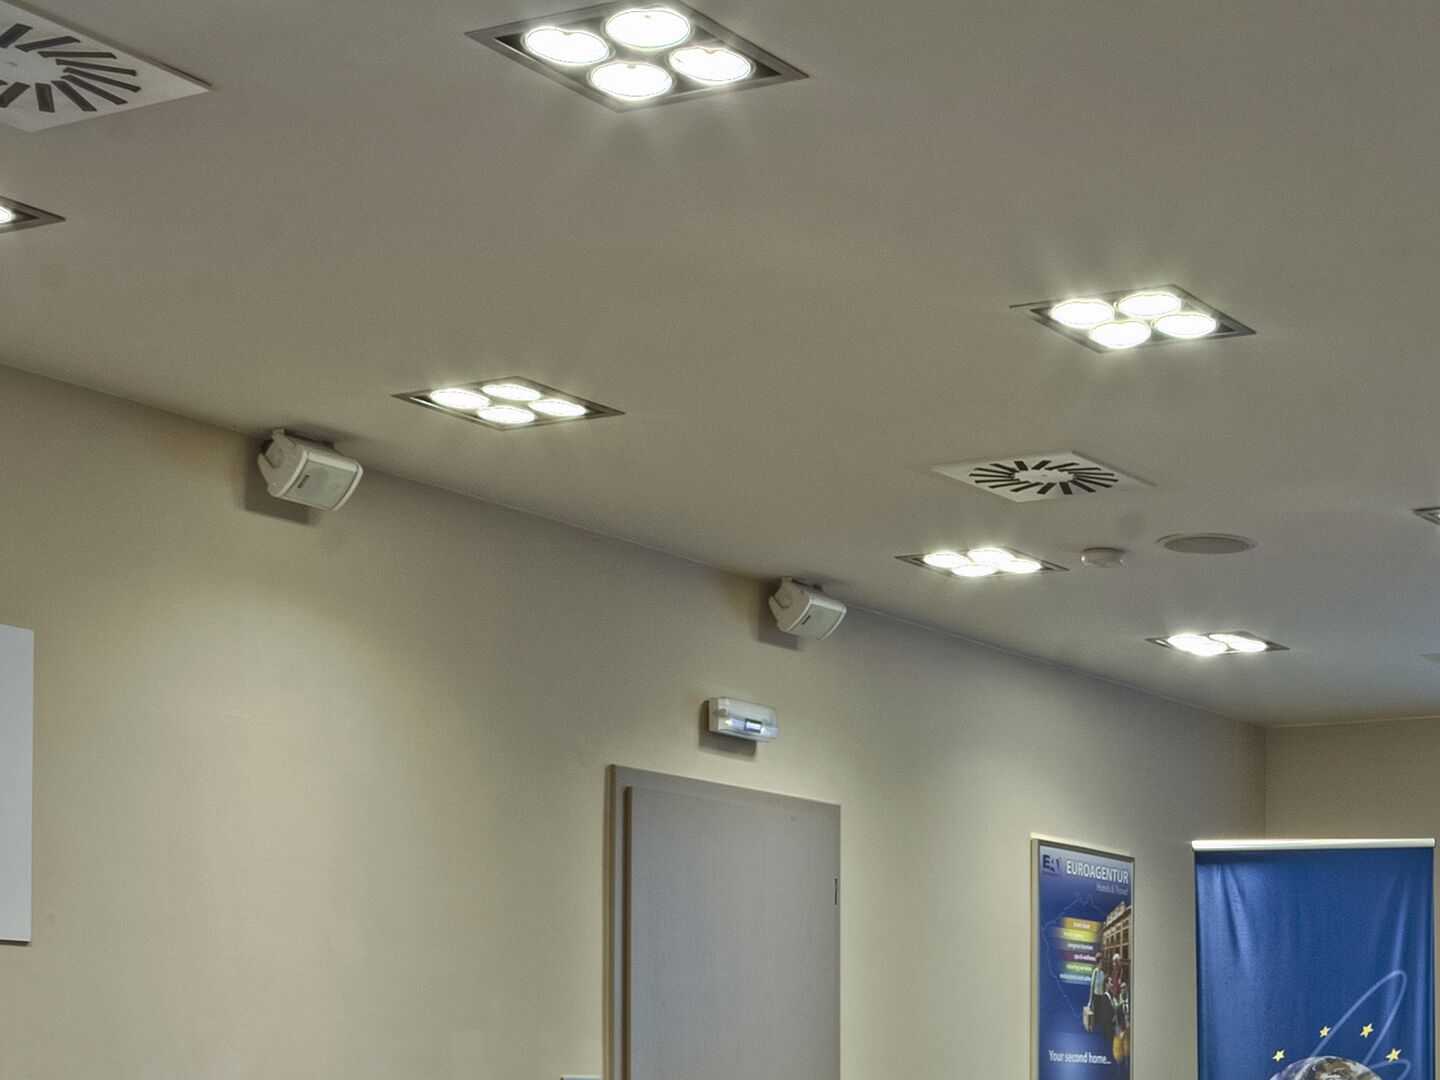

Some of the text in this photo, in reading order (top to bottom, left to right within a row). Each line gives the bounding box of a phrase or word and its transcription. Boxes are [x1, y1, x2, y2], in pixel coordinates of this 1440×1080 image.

[1066, 860, 1129, 884] EUROAGENTUR
[1048, 1049, 1064, 1061] Your
[1064, 1052, 1087, 1063] second
